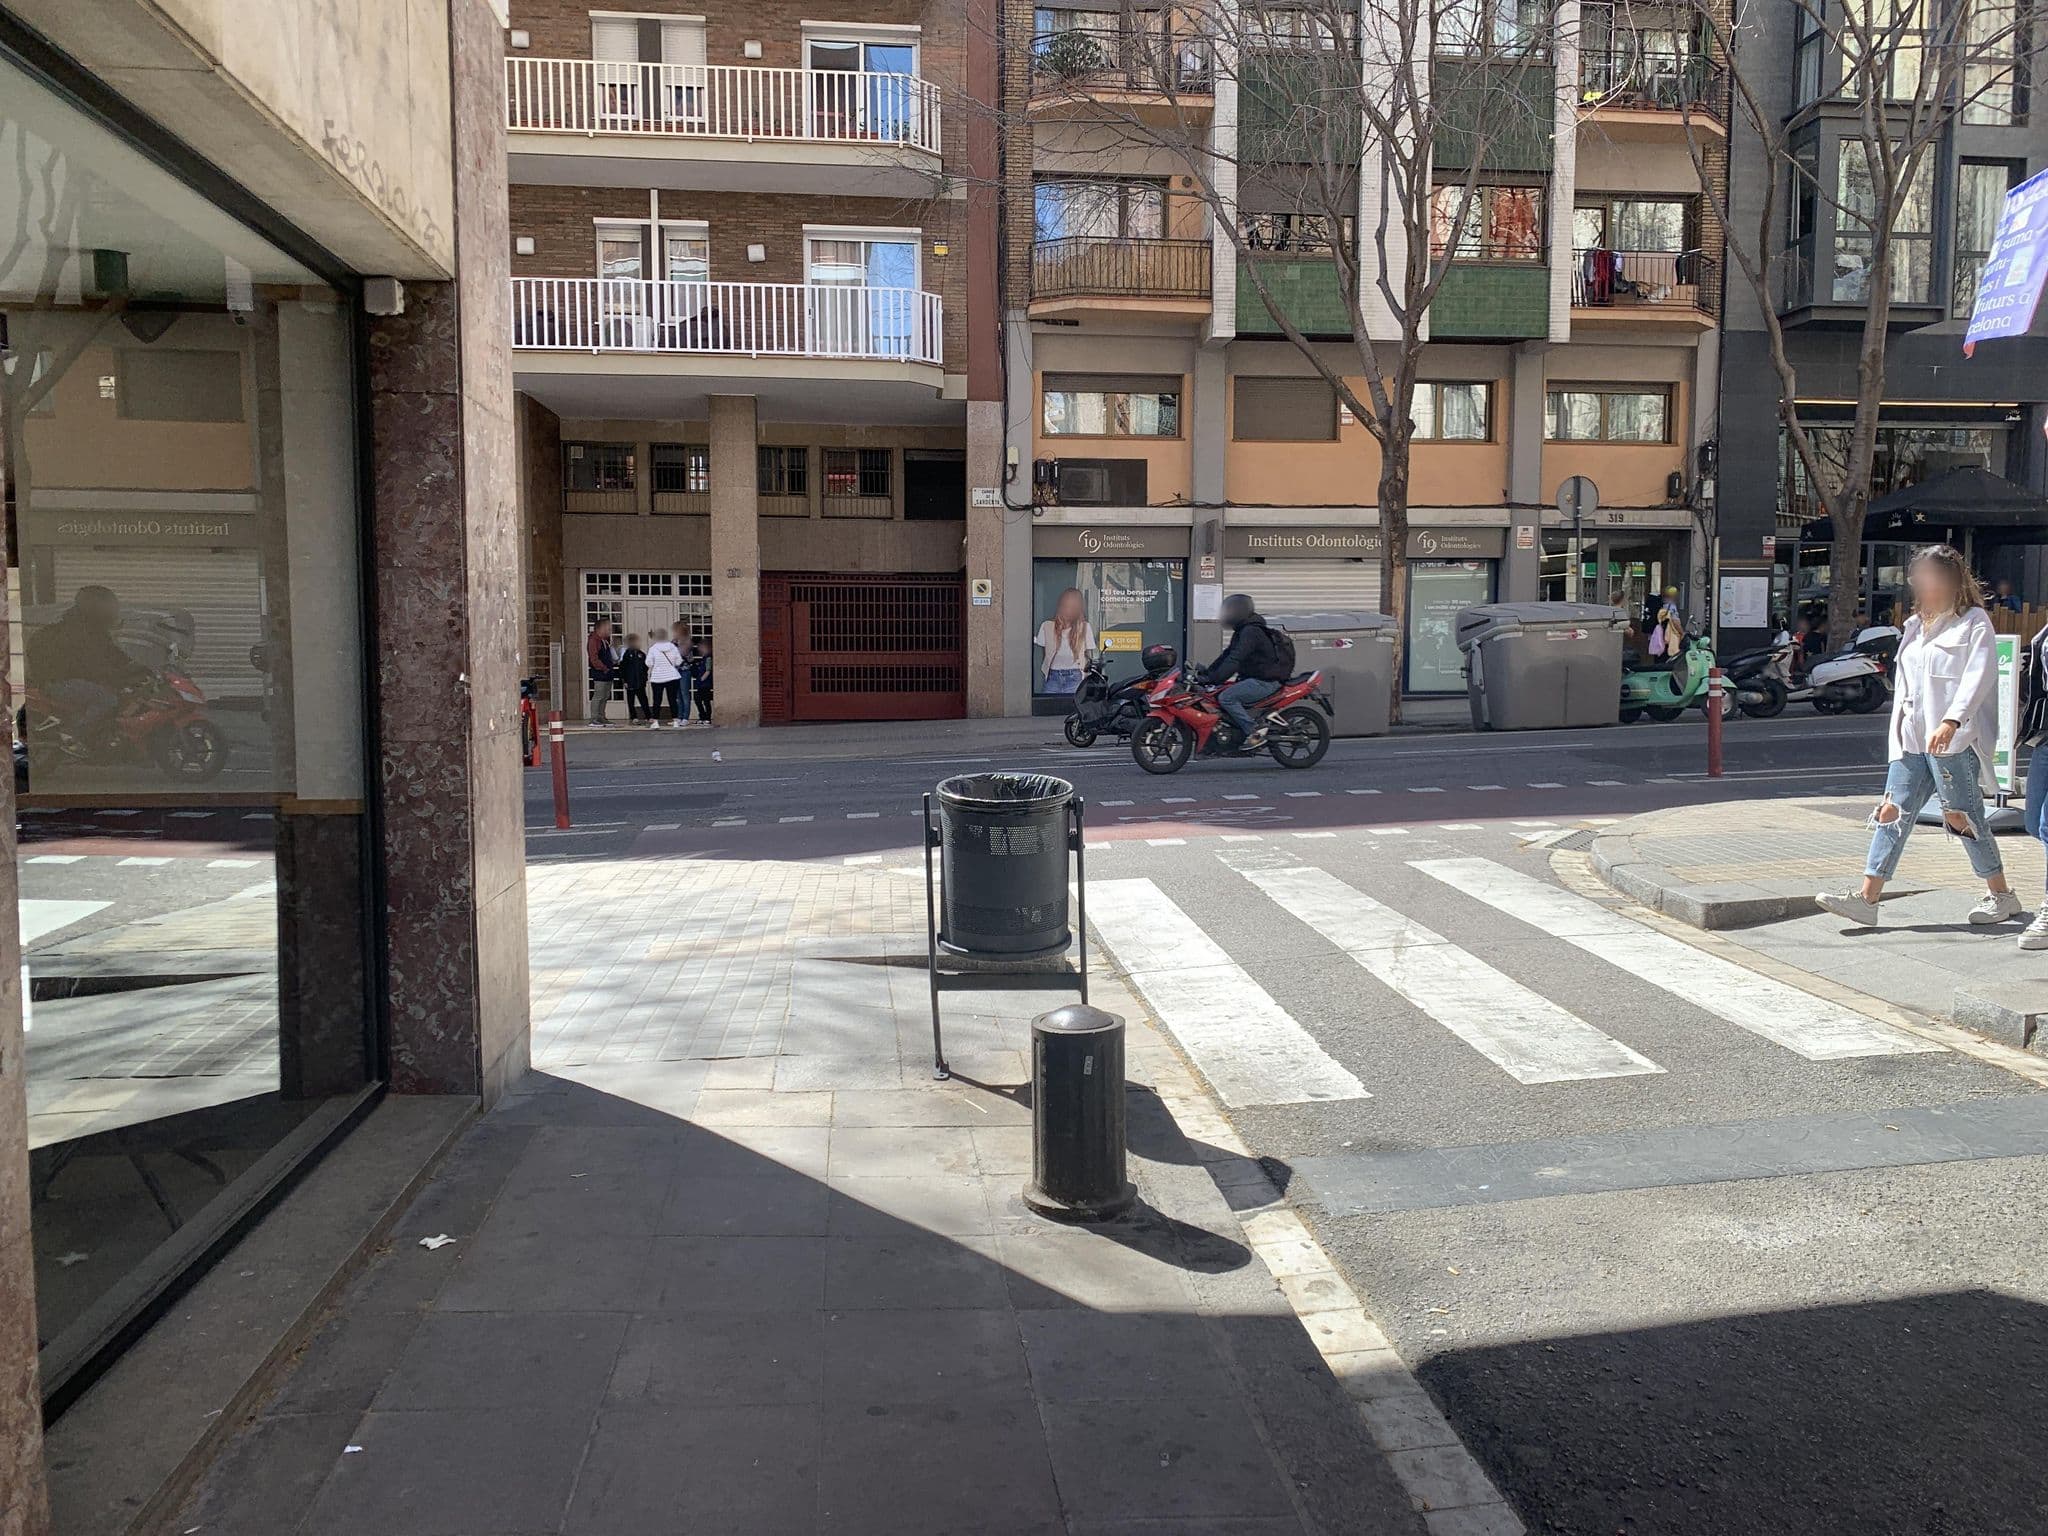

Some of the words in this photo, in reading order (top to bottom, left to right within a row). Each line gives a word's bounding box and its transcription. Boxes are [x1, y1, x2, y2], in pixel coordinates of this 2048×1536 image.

[1608, 513, 1624, 523] 319
[1247, 534, 1303, 548] Instituts
[1306, 534, 1383, 550] Odontològic
